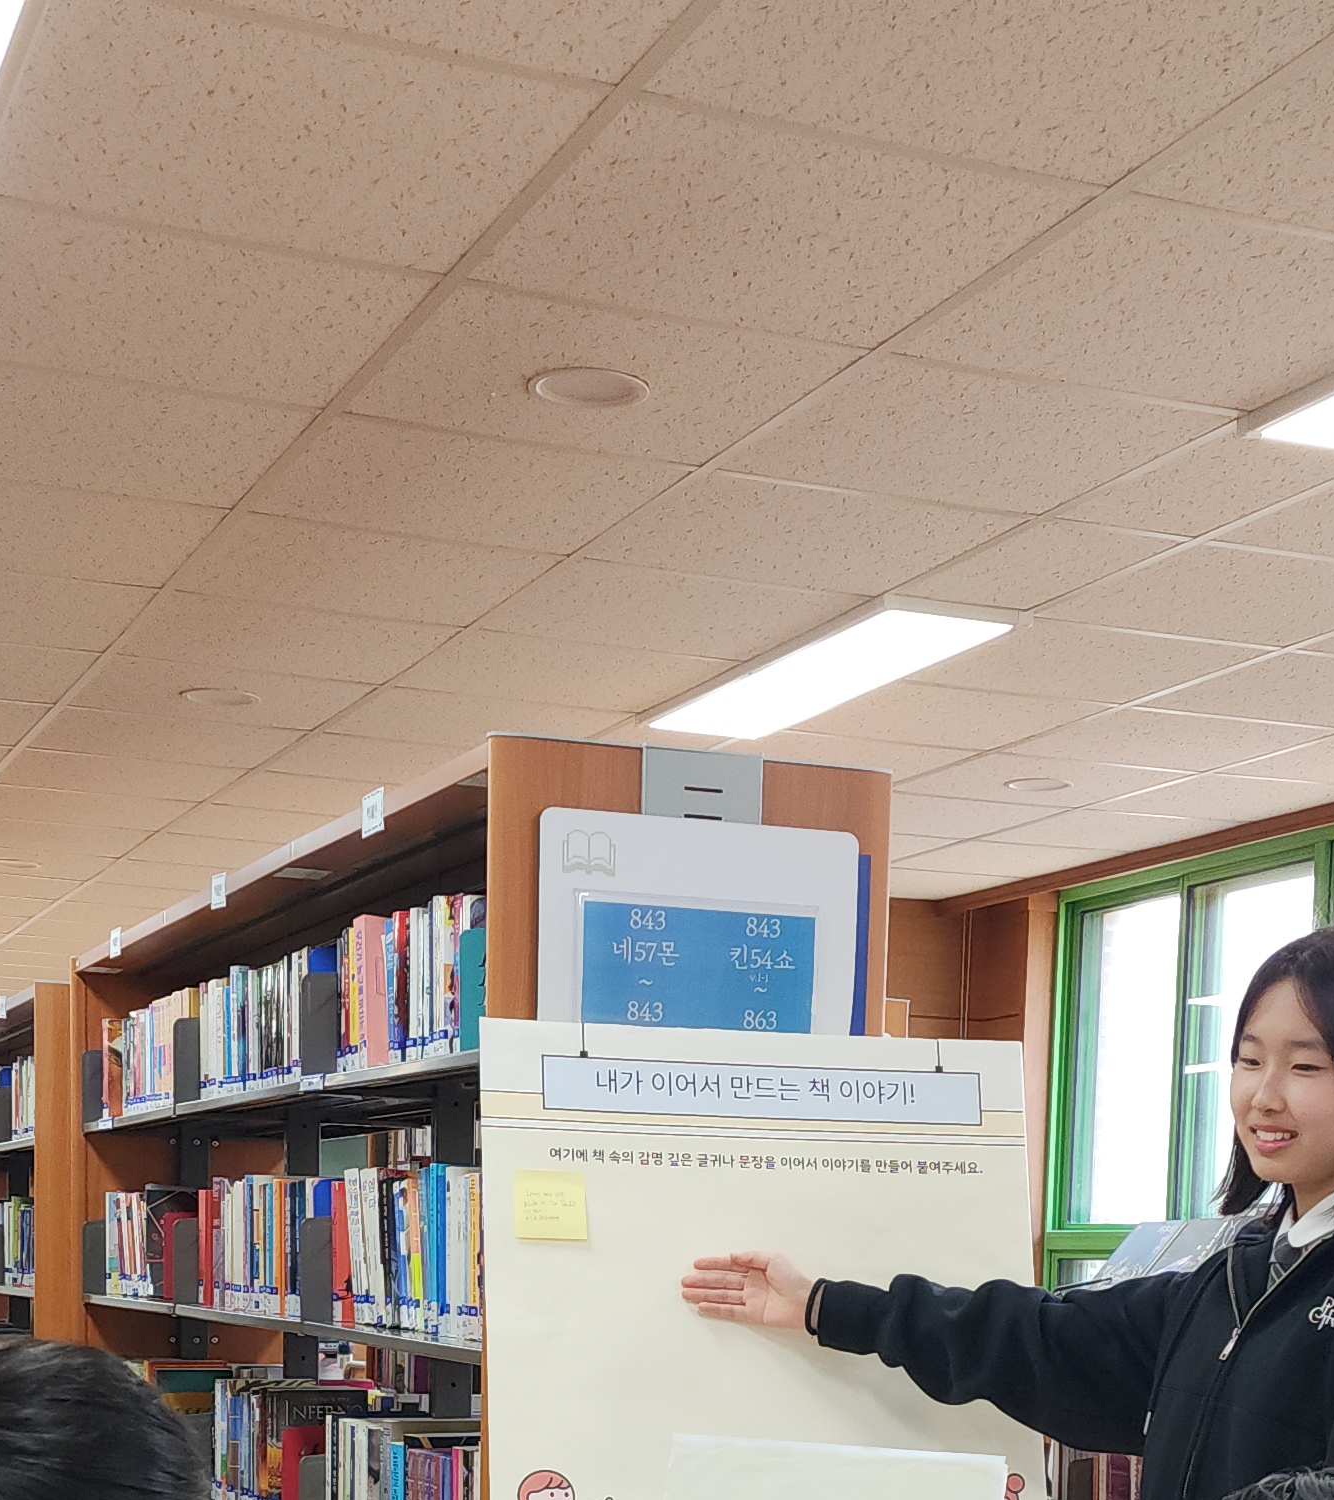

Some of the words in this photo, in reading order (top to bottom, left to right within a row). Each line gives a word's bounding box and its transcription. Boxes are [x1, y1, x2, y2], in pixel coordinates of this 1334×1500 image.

[629, 907, 667, 931] 843
[745, 916, 782, 939] 843
[612, 935, 681, 967] 네57몬
[729, 944, 796, 970] 킨54쇼
[626, 1000, 664, 1023] 843
[742, 1009, 778, 1030] 863
[596, 1069, 644, 1096] 내가
[651, 1072, 722, 1100] 이어서
[730, 1074, 801, 1102] 만드는
[808, 1077, 831, 1103] 책
[839, 1079, 916, 1106] 이야기!
[549, 1147, 588, 1163] 여기에
[592, 1148, 605, 1164] 책
[609, 1150, 634, 1165] 속의
[637, 1151, 664, 1166] 감명
[667, 1152, 694, 1167] 깊은
[696, 1153, 735, 1169] 글귀나
[738, 1155, 777, 1170] 문장을
[780, 1156, 818, 1171] 이어서
[821, 1157, 872, 1173] 이야기를
[875, 1159, 913, 1174] 만들어
[916, 1160, 984, 1175] 붙여주세요.
